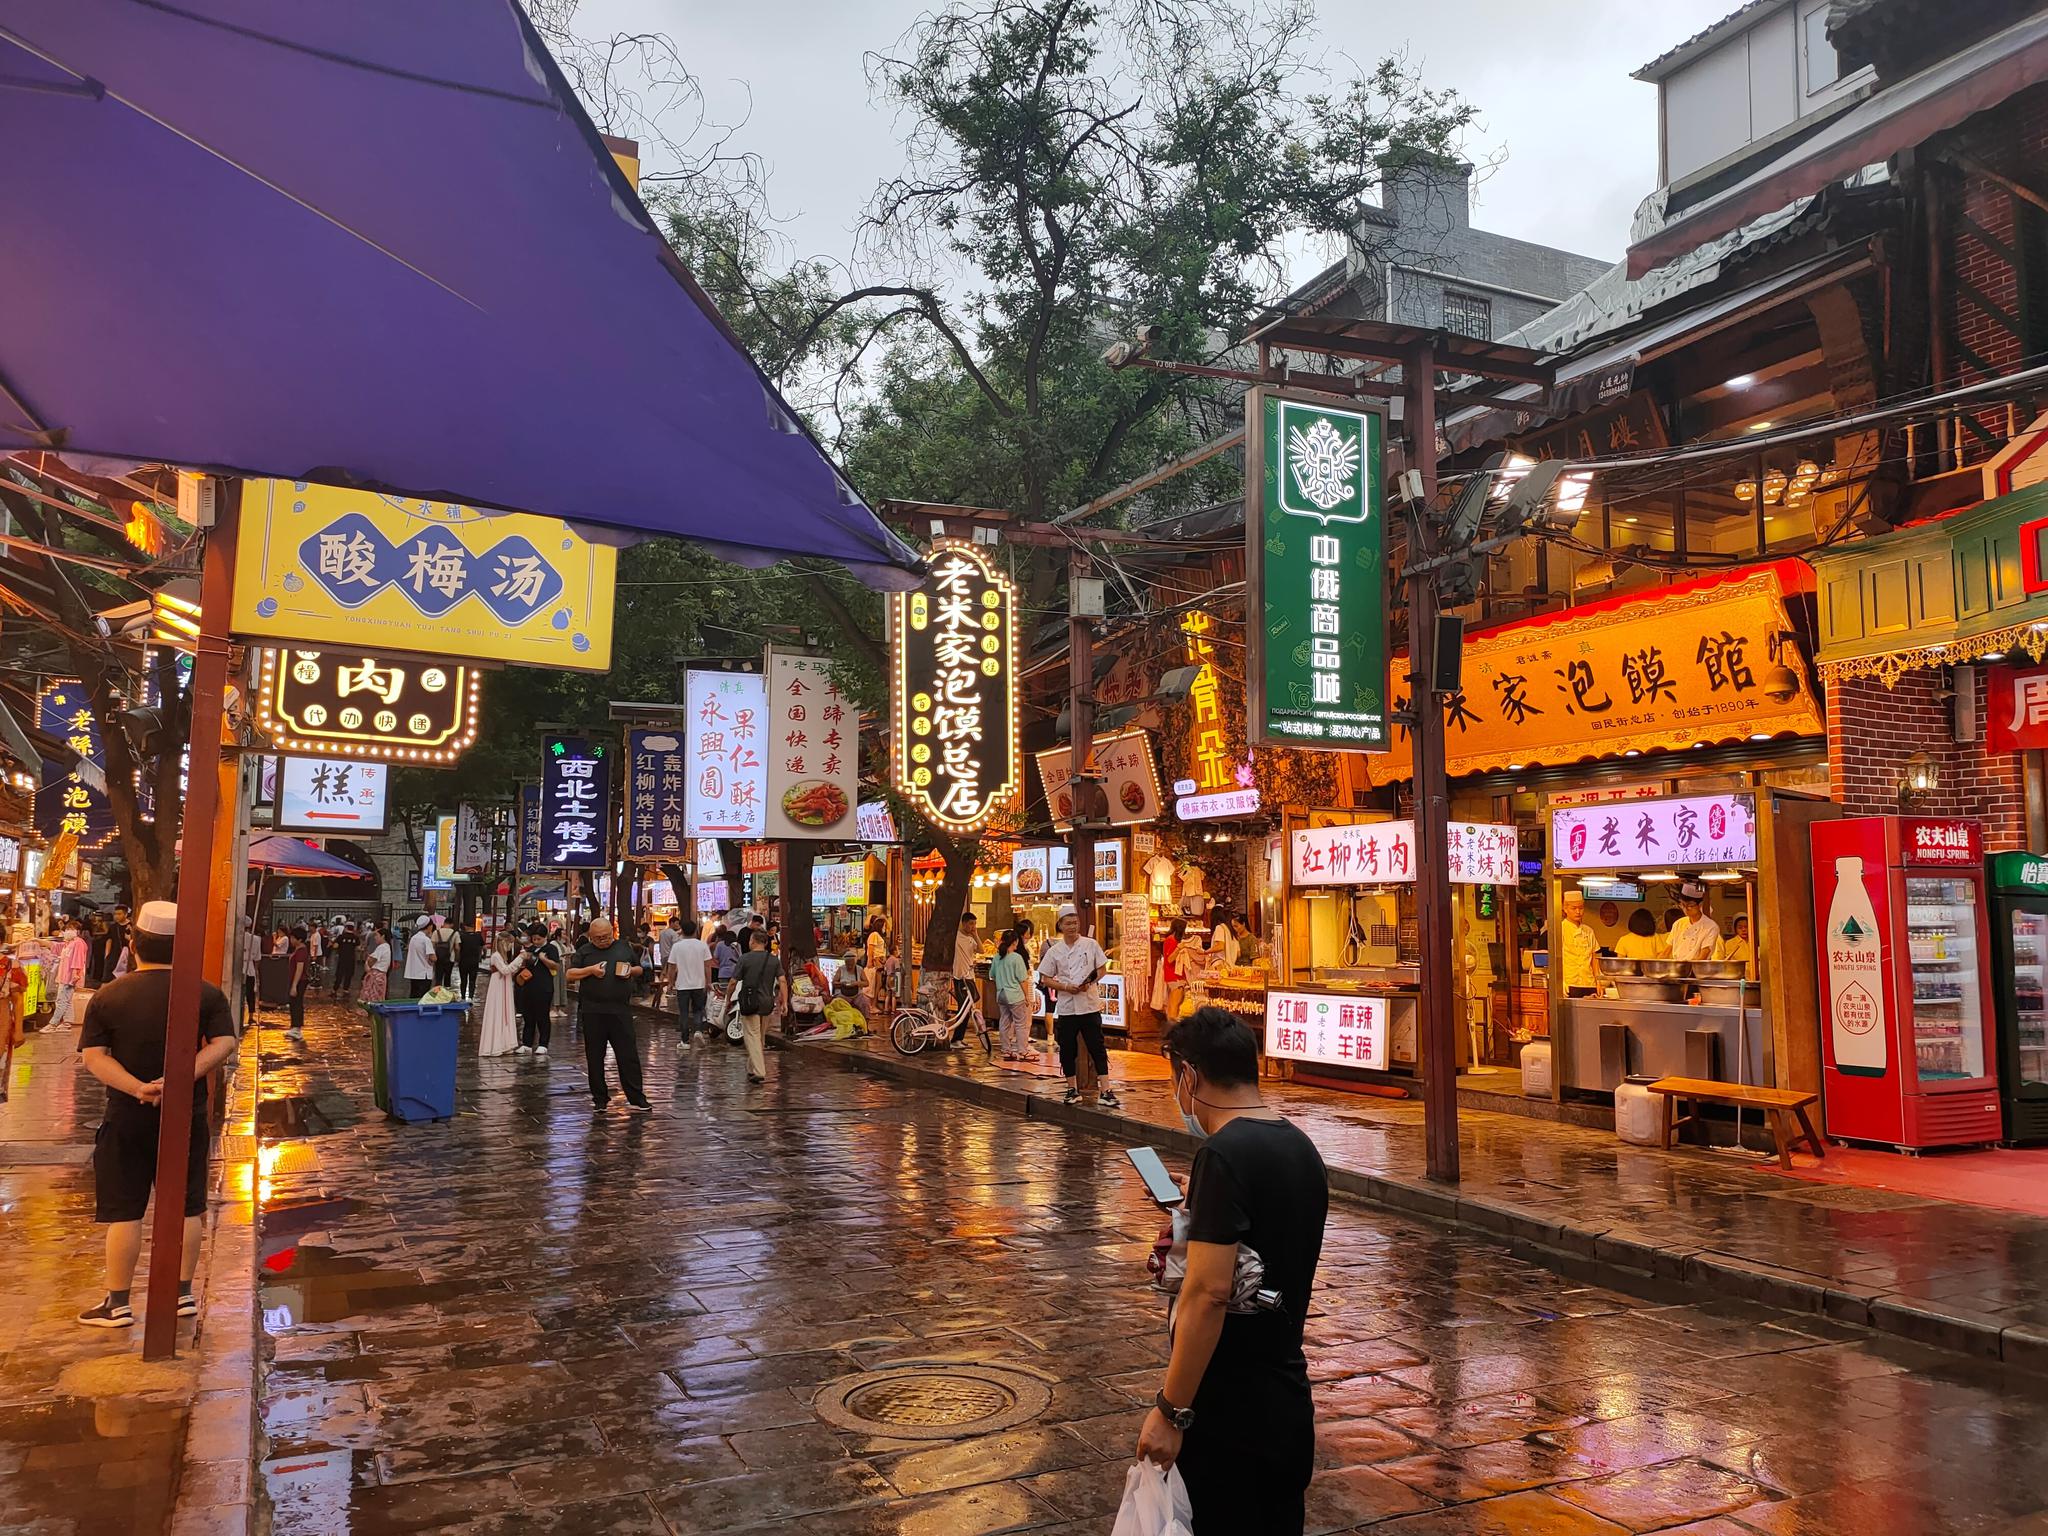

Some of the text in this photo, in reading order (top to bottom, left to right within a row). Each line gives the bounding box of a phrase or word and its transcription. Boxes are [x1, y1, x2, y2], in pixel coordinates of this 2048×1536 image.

[319, 530, 546, 607] 酸梅汤
[1310, 534, 1341, 704] 中俄商品城
[337, 658, 405, 705] 肉
[719, 680, 745, 695] 清真
[933, 557, 982, 816] 老米家泡馍总店
[307, 707, 428, 732] 代办快递
[785, 677, 811, 775] 全国快递
[1591, 698, 1760, 731] 回民街总店 创始于1890年
[697, 692, 729, 800] 永興圓
[729, 708, 761, 808] 果仁酥
[914, 697, 928, 784] 百年老店
[310, 762, 355, 806] 糕
[635, 754, 656, 852] 红柳烤羊肉
[662, 754, 683, 852] 轰炸大鱿鱼
[552, 758, 599, 862] 西北土特产
[702, 809, 756, 823] 百年老店
[1477, 831, 1515, 856] 紅柳
[1571, 828, 1586, 860] 百年
[1598, 804, 1701, 857] 老米家
[1915, 825, 1969, 848] 农夫山泉
[1302, 833, 1409, 878] 紅柳烤肉
[1466, 837, 1476, 878] 老米家
[1477, 853, 1515, 879] 烤肉
[1667, 844, 1749, 863] 回民街创始店
[1917, 848, 1970, 860] NONGFU SPRING
[1832, 950, 1876, 963] 农夫山泉
[1277, 999, 1308, 1024] 红柳
[1339, 1004, 1373, 1030] 麻辣
[1843, 1002, 1871, 1011] 农夫山泉
[1276, 1027, 1307, 1054] 烤肉
[1317, 1016, 1327, 1056] 老米家
[1338, 1034, 1372, 1061] 羊蹄
